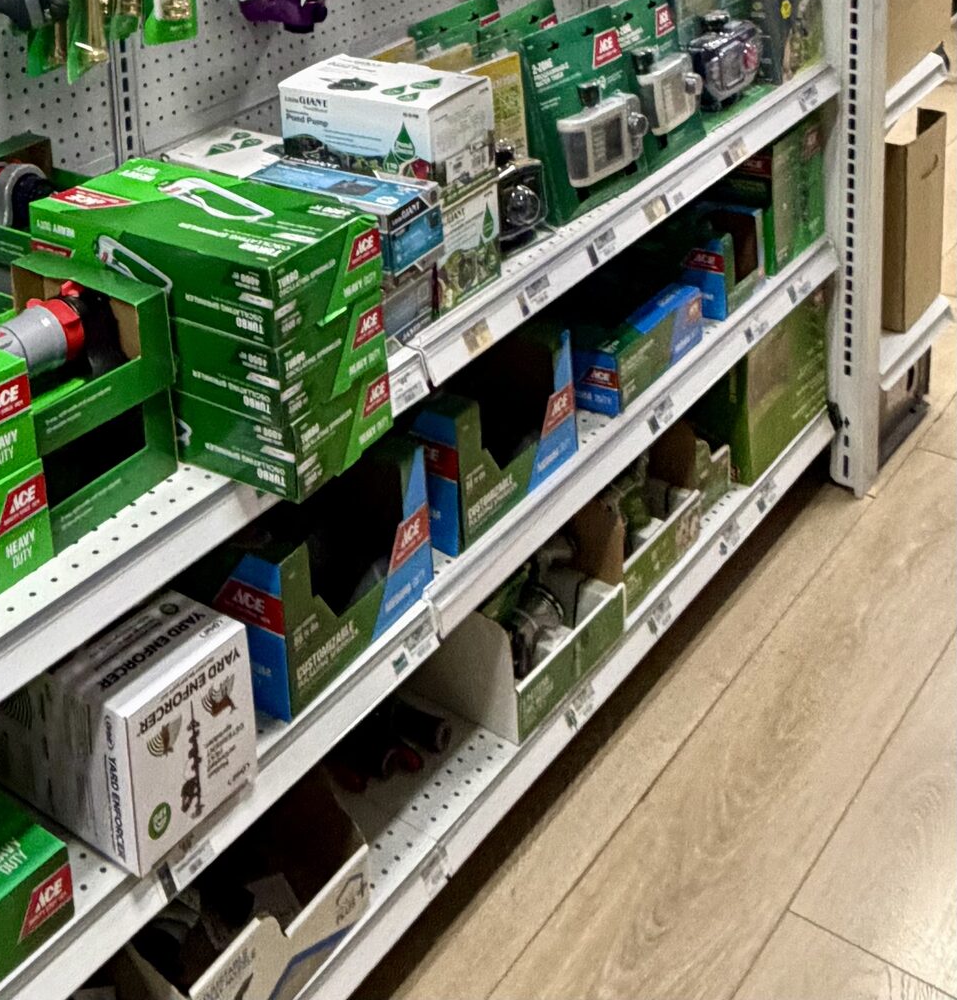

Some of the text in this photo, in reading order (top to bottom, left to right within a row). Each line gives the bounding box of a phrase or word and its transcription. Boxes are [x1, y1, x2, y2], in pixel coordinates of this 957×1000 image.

[355, 234, 374, 257] ACE
[236, 317, 265, 335] TURBO
[360, 312, 378, 335] ACE
[243, 395, 272, 415] TURBO
[257, 467, 287, 488] TURBO
[9, 484, 36, 516] ACE
[5, 527, 36, 559] HEAVY
[12, 546, 33, 569] DUTY
[98, 611, 206, 692] YARD ENFORCER
[138, 647, 241, 737] YARD ENFORCER
[108, 756, 127, 863] YARD ENFORCER
[34, 876, 64, 914] ACE
